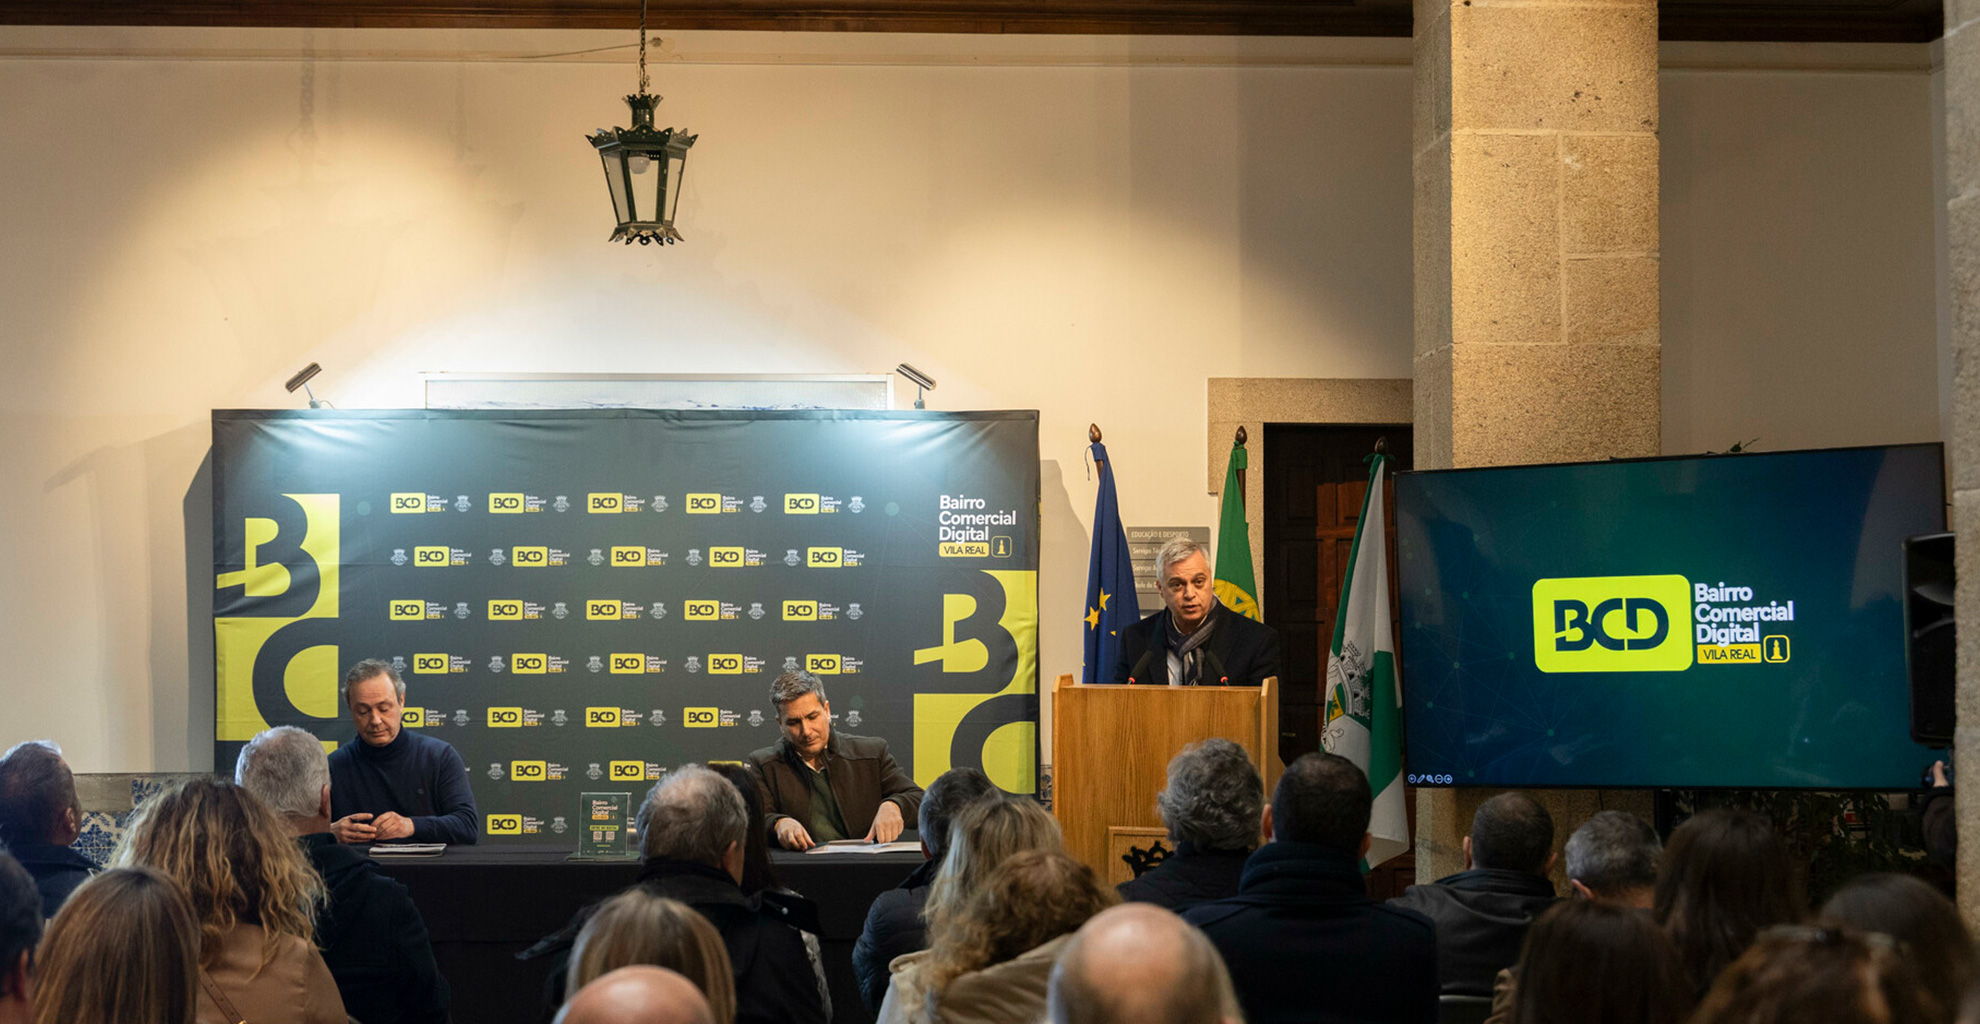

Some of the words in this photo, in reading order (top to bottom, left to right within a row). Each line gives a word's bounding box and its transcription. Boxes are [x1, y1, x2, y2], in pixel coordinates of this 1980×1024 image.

[396, 498, 421, 508] BCD
[494, 498, 519, 508] BCD
[593, 498, 618, 508] BCD
[691, 498, 716, 509] BCD
[790, 498, 814, 509] BCD
[939, 494, 985, 509] Bairro
[939, 510, 1016, 525] Comercial
[939, 526, 988, 544] Digital
[1131, 530, 1158, 540] EDUCAÇÃO
[944, 546, 963, 554] VILA
[965, 546, 985, 554] REAL
[419, 551, 444, 562] BCD
[518, 551, 543, 562] BCD
[616, 551, 641, 562] BCD
[715, 552, 740, 563] BCD
[813, 552, 837, 563] BCD
[1695, 582, 1753, 602] Bairro
[395, 605, 420, 616] BCD
[493, 605, 518, 616] BCD
[592, 605, 616, 616] BCD
[690, 605, 714, 616] BCD
[788, 605, 813, 616] BCD
[1695, 601, 1794, 622] Comercial
[1554, 598, 1669, 651] BCD
[1696, 622, 1760, 647] Digital
[1703, 650, 1728, 660] VILA
[1730, 649, 1756, 660] REAL
[419, 658, 444, 669] BCD
[517, 658, 542, 669] BCD
[615, 658, 640, 669] BCD
[713, 659, 738, 670] BCD
[811, 659, 836, 670] BCD
[402, 712, 420, 723] CD
[493, 712, 518, 723] BCD
[591, 712, 616, 723] BCD
[689, 712, 714, 723] BCD
[516, 765, 541, 776] BCD
[615, 765, 640, 776] BCD
[492, 819, 517, 830] BCD
